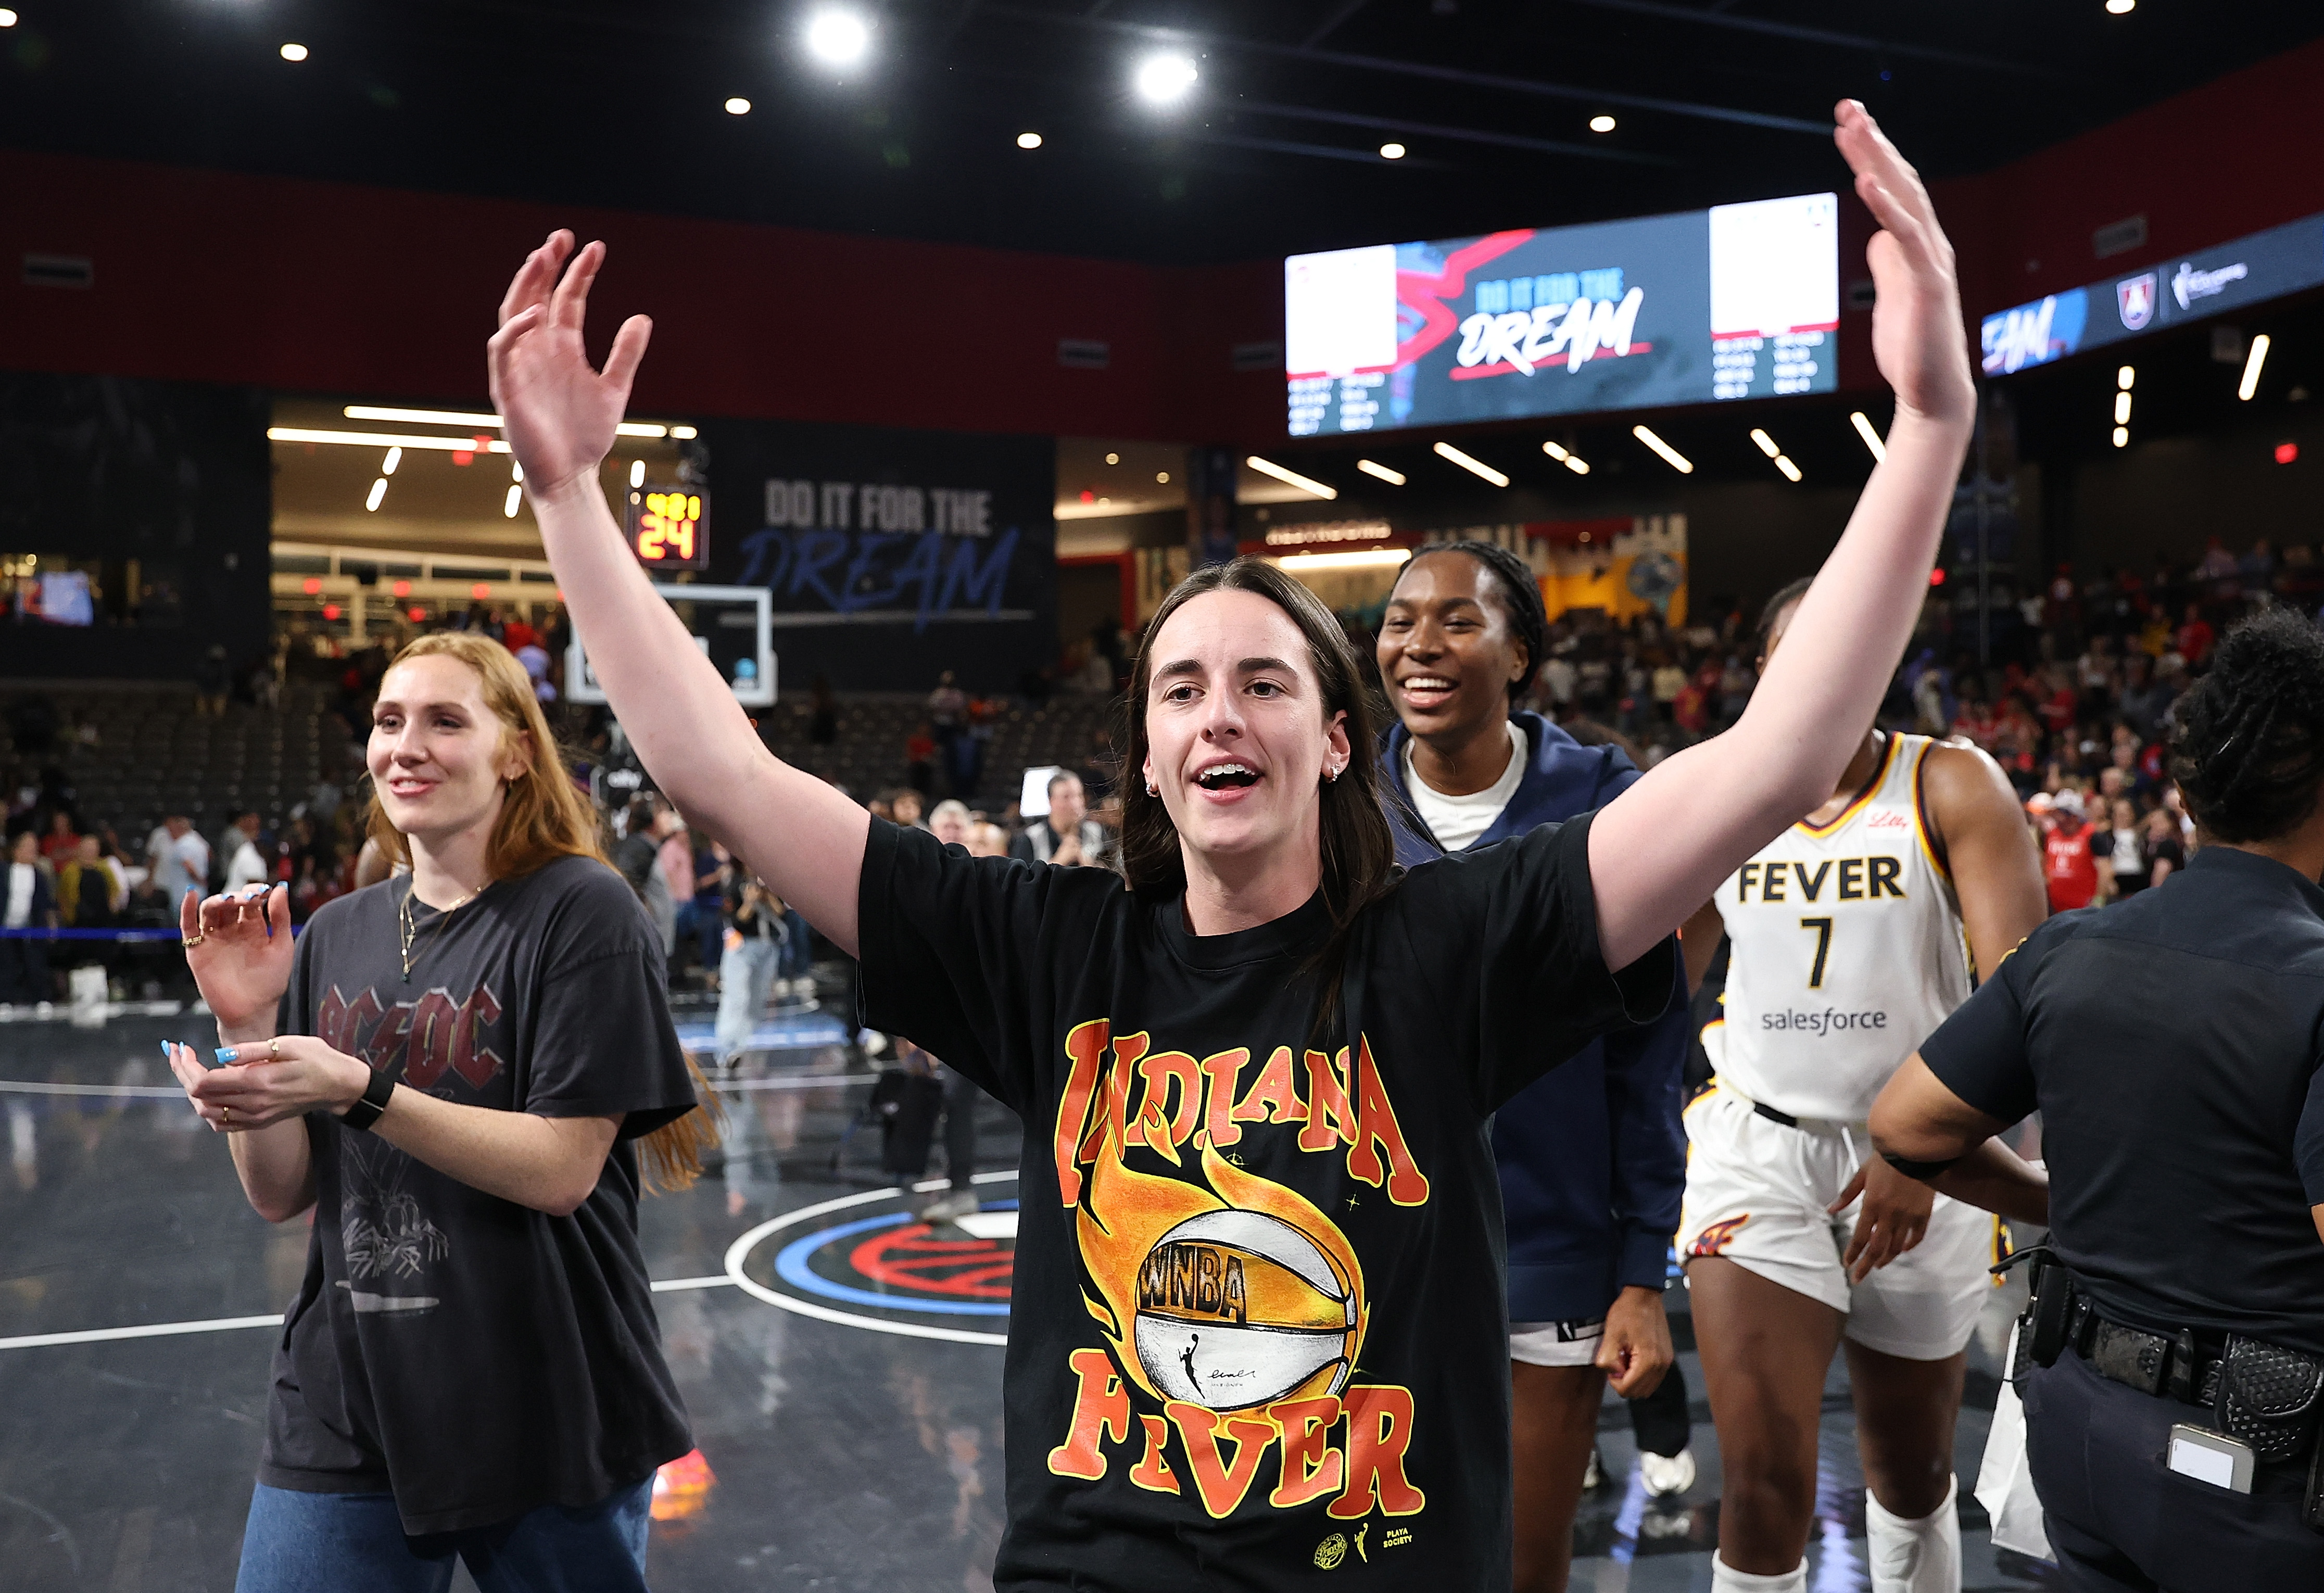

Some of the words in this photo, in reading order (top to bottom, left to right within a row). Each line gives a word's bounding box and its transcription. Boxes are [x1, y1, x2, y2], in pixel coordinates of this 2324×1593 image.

[1457, 287, 1643, 376] DREAM
[638, 514, 694, 560] 24
[765, 479, 813, 527] DO
[820, 482, 854, 529] IT
[860, 484, 925, 533] FOR
[931, 488, 991, 537] THE
[736, 526, 1021, 634] DREAM
[1738, 856, 1909, 905] FEVER
[1800, 915, 1833, 990] 7
[1761, 1007, 1887, 1036] salesforce
[1054, 1018, 1430, 1207] INDIANA
[1139, 1244, 1247, 1325] WNBA
[1047, 1348, 1425, 1519] FEVER
[1383, 1535, 1412, 1548] SOCIETY
[1387, 1527, 1408, 1538] PLAYA
